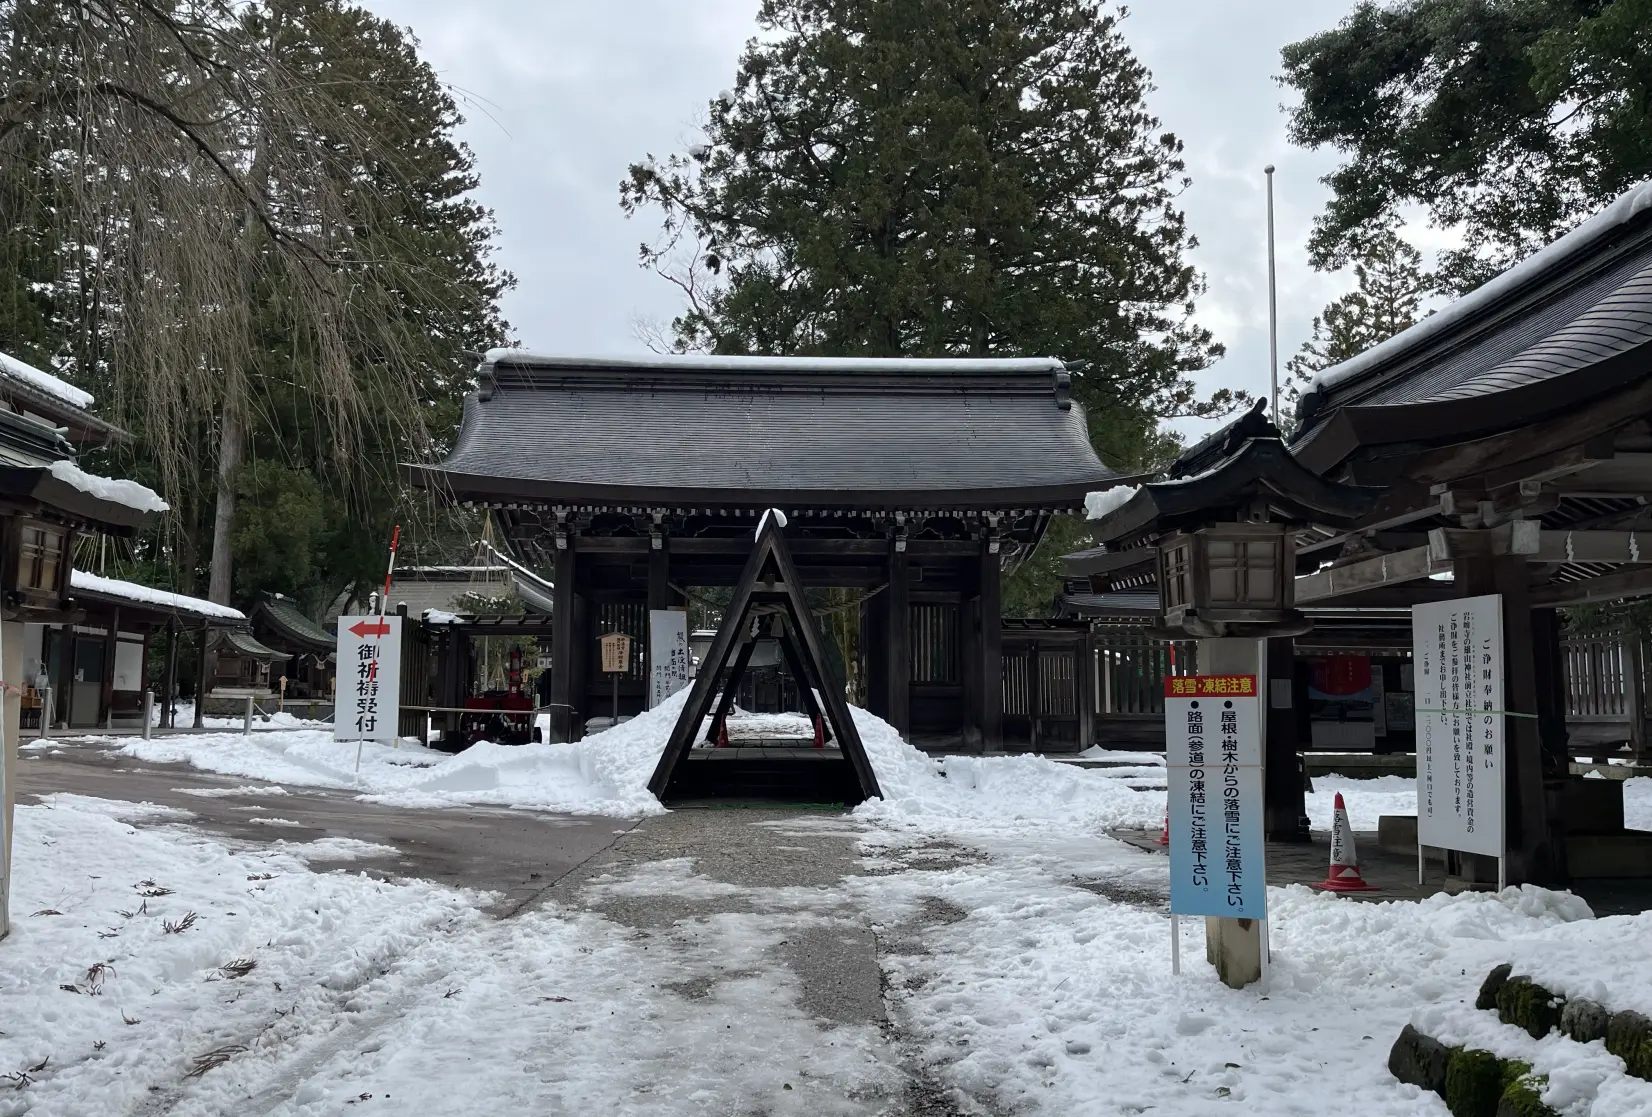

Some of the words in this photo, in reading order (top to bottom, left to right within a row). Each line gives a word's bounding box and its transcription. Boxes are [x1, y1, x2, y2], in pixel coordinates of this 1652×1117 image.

[355, 643, 380, 732] 御祈祷受付
[1172, 678, 1252, 694] 落雪・凍結注意
[1482, 638, 1494, 769] ご浄財奉納のお願い
[1187, 711, 1209, 892] 路面(参道)の凍結にご注意下さい。
[1221, 711, 1244, 913] 屋根・樹木からの落雪にご注意下さい。
